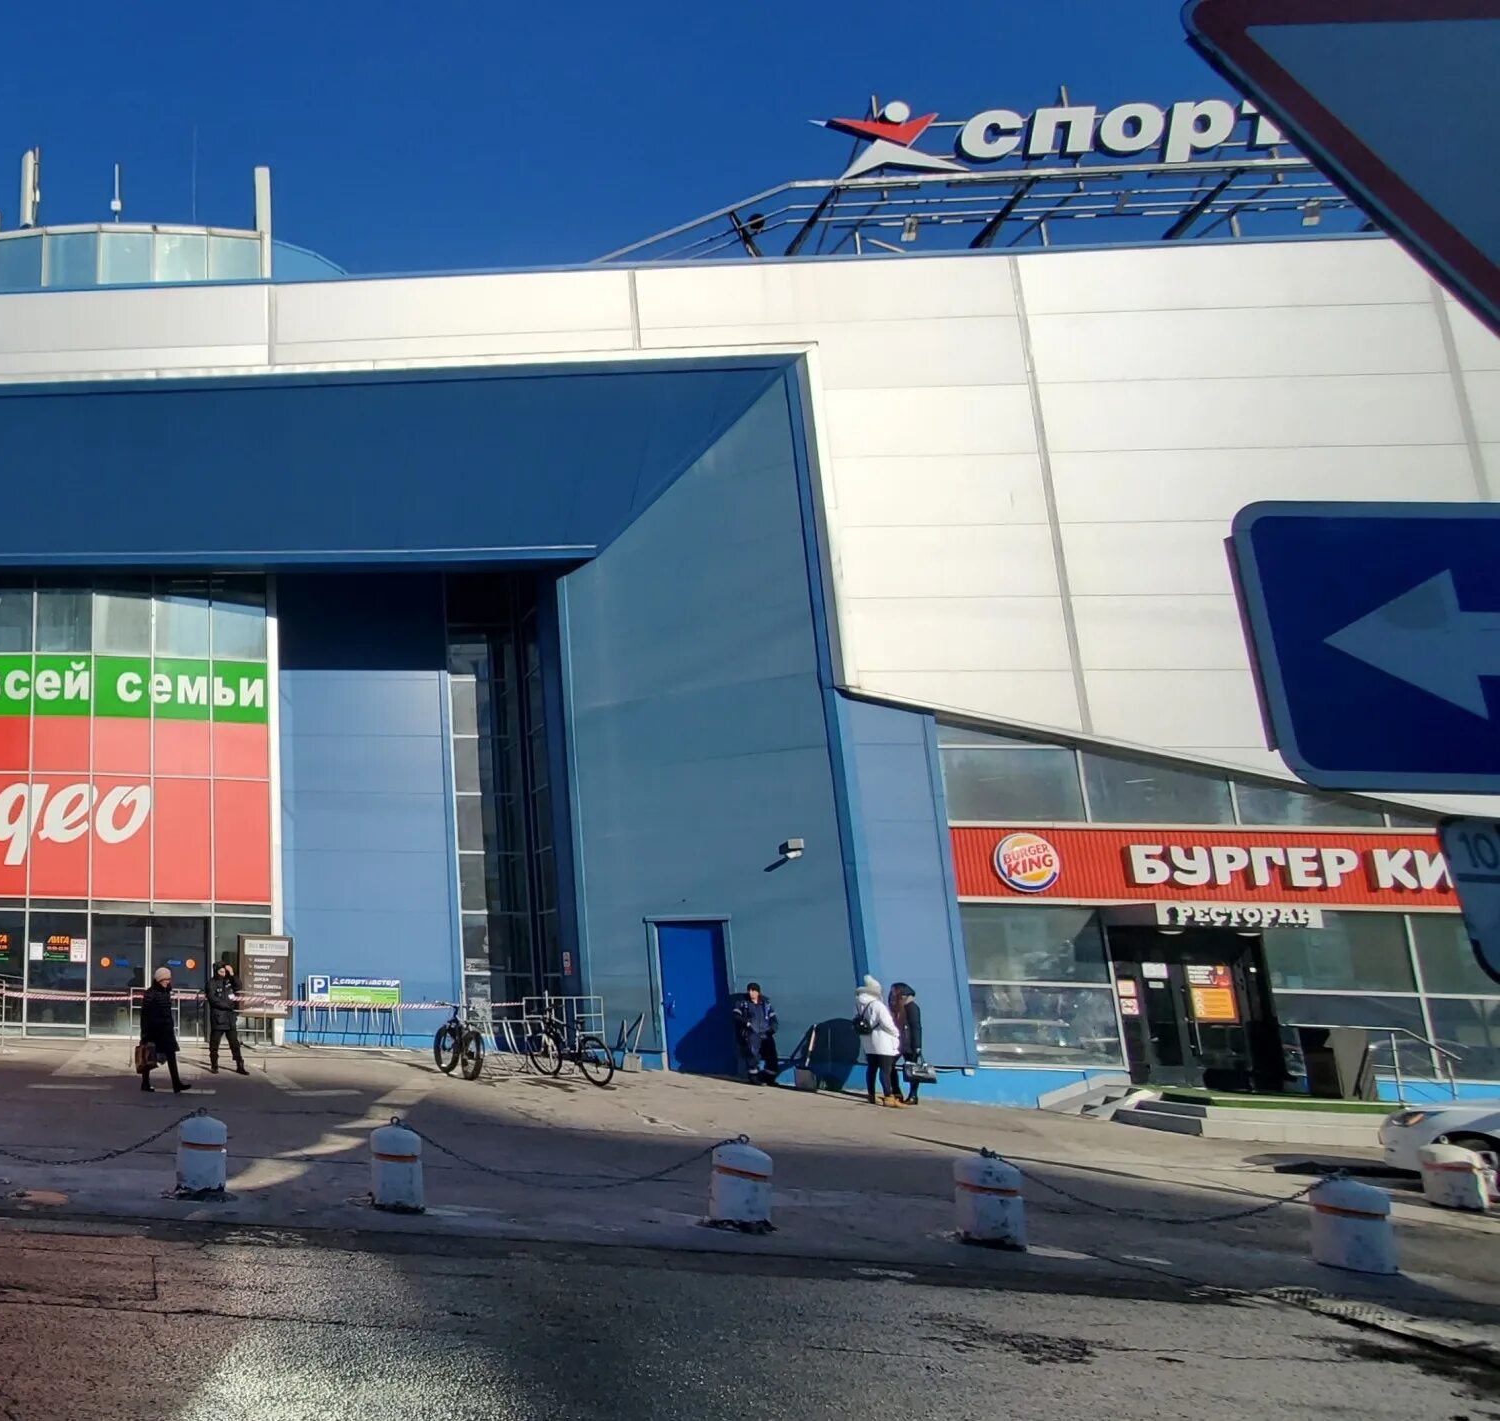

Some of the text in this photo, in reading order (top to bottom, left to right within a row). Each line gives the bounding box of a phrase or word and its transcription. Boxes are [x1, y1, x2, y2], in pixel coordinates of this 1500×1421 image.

[116, 672, 264, 708] семьи
[1003, 844, 1049, 864] BURGER
[1007, 854, 1053, 878] KING
[1127, 844, 1359, 889] БУРГЕР
[1175, 907, 1313, 928] РЕСТОРАН
[313, 978, 326, 993] P
